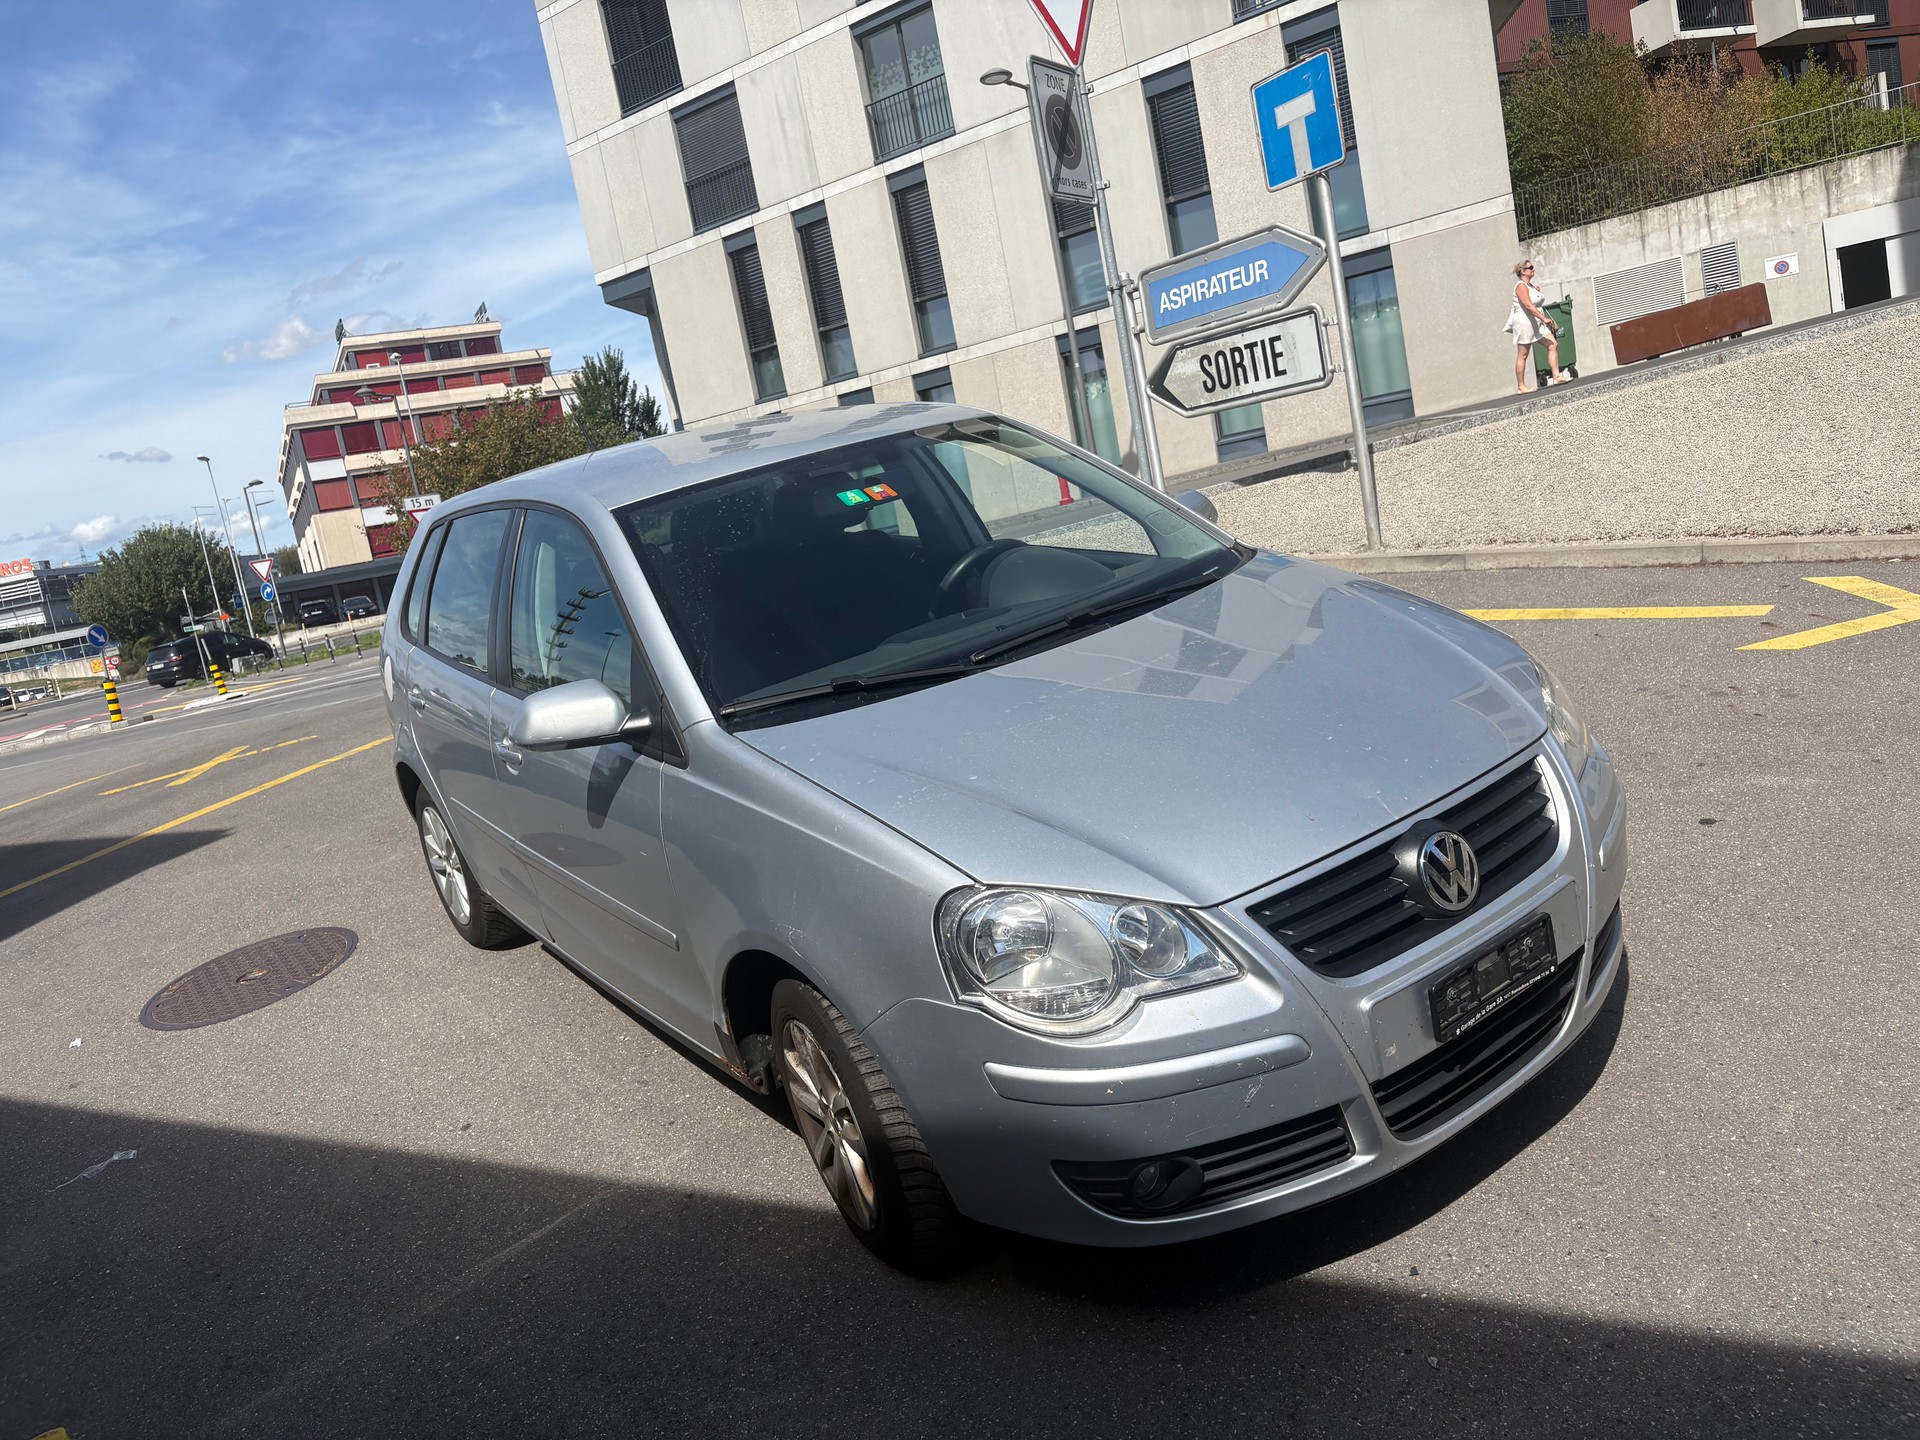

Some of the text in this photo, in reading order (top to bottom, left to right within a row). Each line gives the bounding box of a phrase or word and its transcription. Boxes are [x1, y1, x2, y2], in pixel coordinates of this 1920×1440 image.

[1044, 73, 1066, 93] ZONE
[1071, 179, 1087, 189] cases
[1160, 259, 1269, 314] ASPIRATEUR
[1199, 334, 1287, 393] SORTIE
[410, 498, 434, 508] 15 m
[1460, 1017, 1475, 1031] Garage
[1485, 1001, 1496, 1012] Gare
[1496, 996, 1503, 1004] SA
